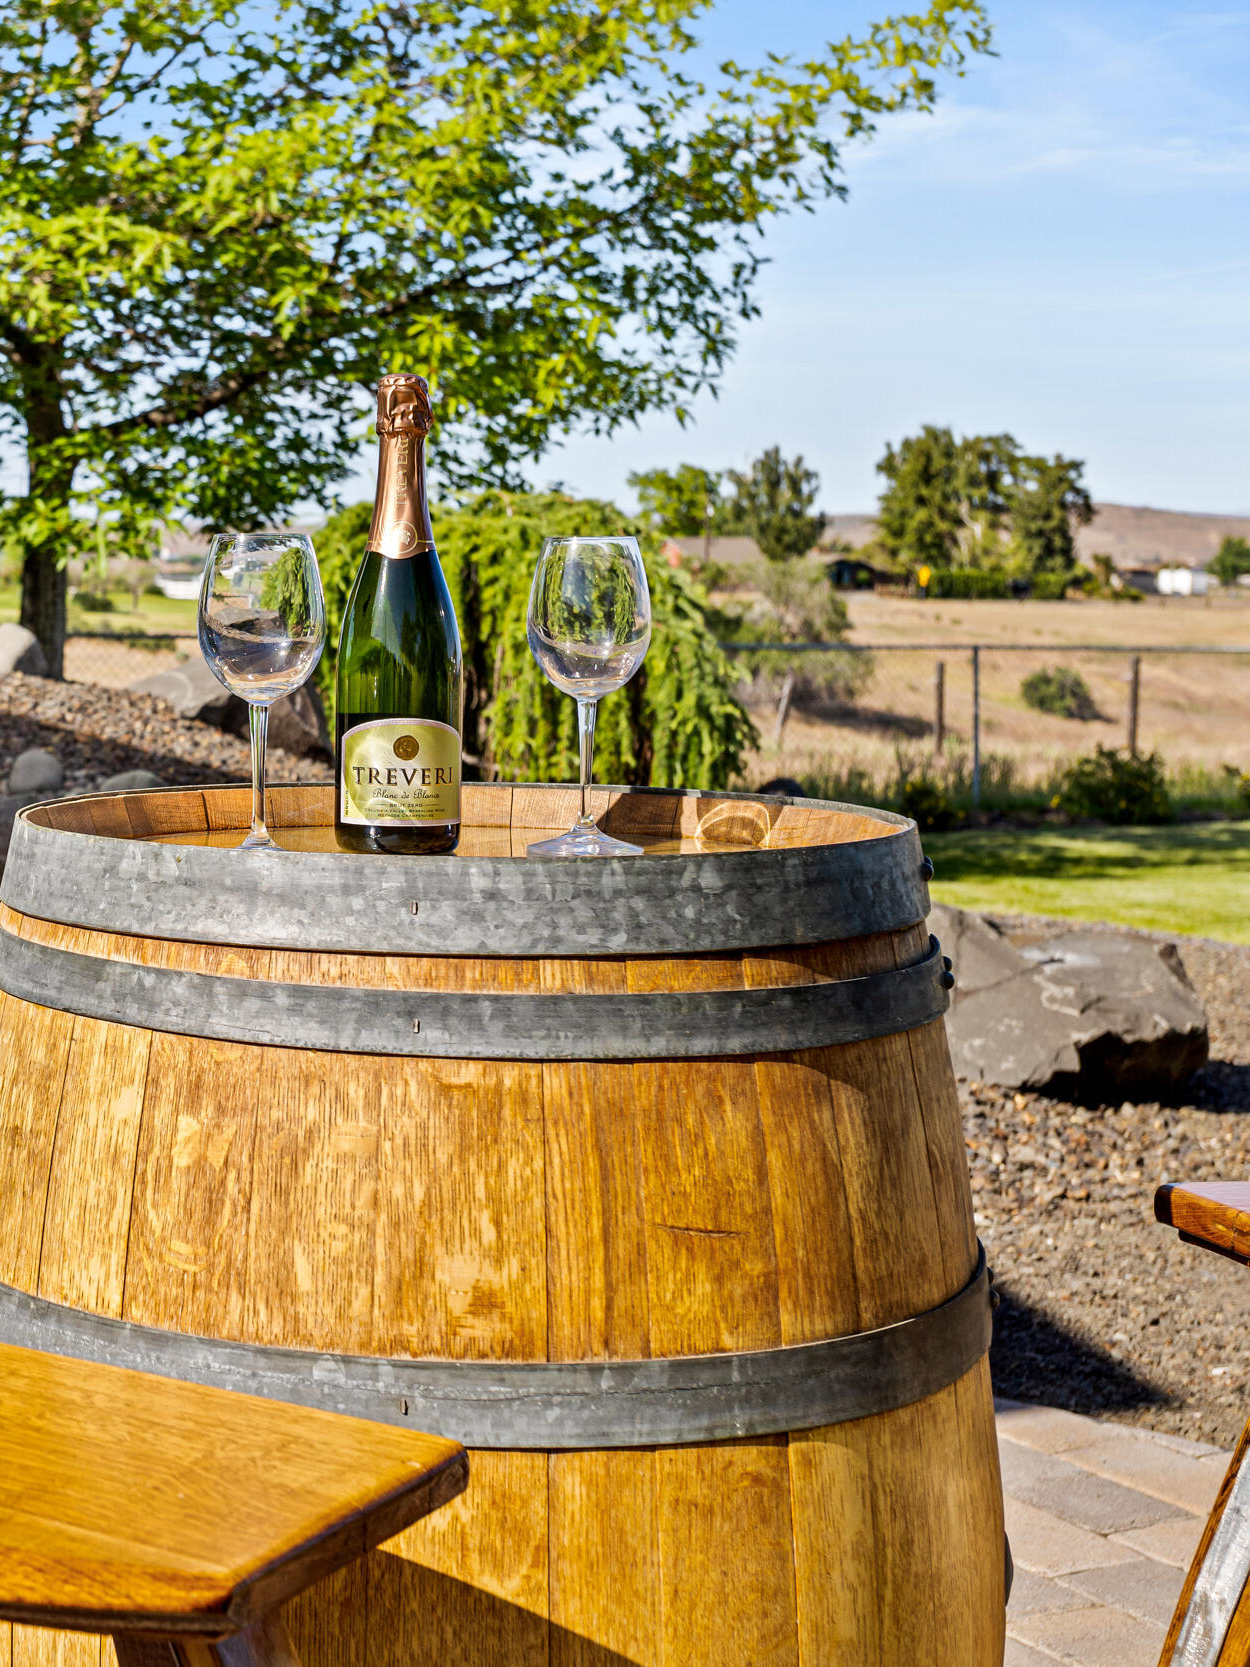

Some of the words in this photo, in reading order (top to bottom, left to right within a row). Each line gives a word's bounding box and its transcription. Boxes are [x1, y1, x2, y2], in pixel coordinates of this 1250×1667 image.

[352, 765, 454, 786] TREVERI
[372, 787, 398, 799] Blanc
[401, 791, 410, 799] de
